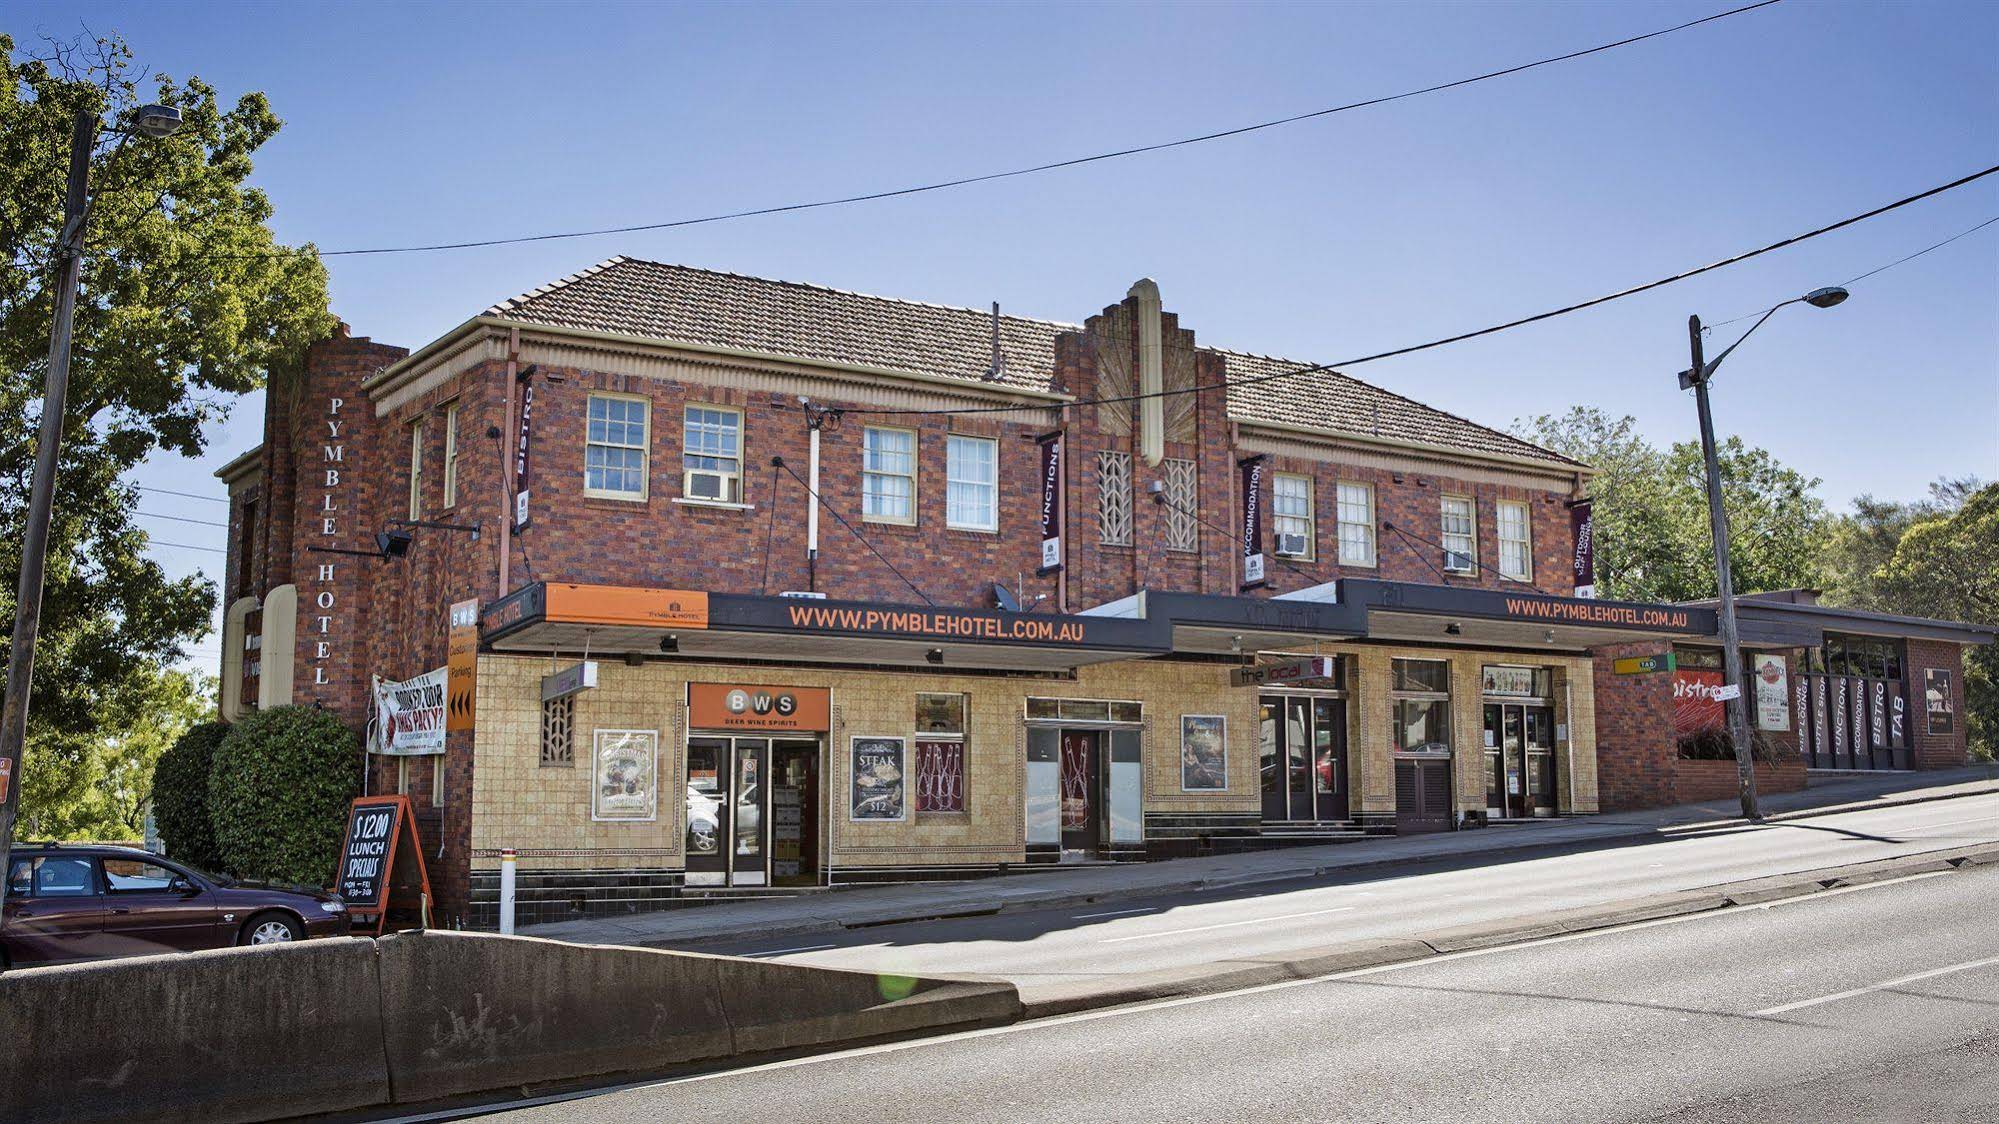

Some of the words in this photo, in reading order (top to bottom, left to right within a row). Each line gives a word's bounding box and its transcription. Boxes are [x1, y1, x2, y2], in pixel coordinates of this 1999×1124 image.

[518, 387, 533, 475] BISTRO
[322, 398, 344, 535] PYMBLE
[1042, 444, 1059, 535] FUNCTIONS
[1245, 465, 1261, 557] ACCOMMODATION
[1574, 523, 1586, 569] OUTDOOR
[315, 564, 335, 685] HOTEL
[452, 606, 475, 627] BWS
[789, 606, 1084, 641] WWW.PYMBLEHOTEL.COM.AU
[1506, 598, 1687, 627] WWW.PYMBLEHOTEL.COM.AU
[452, 666, 472, 678] Parking
[1241, 668, 1264, 683] the
[1267, 664, 1301, 680] local
[1818, 676, 1826, 707] SHOP
[1800, 677, 1809, 726] LOUNGE
[1855, 678, 1864, 755] ACCOMMODATION
[1873, 682, 1884, 745] BISTRO
[1892, 696, 1904, 738] TAB
[859, 755, 896, 767] STEAK
[347, 857, 380, 878] SPECIALS
[350, 842, 385, 856] LUNCH
